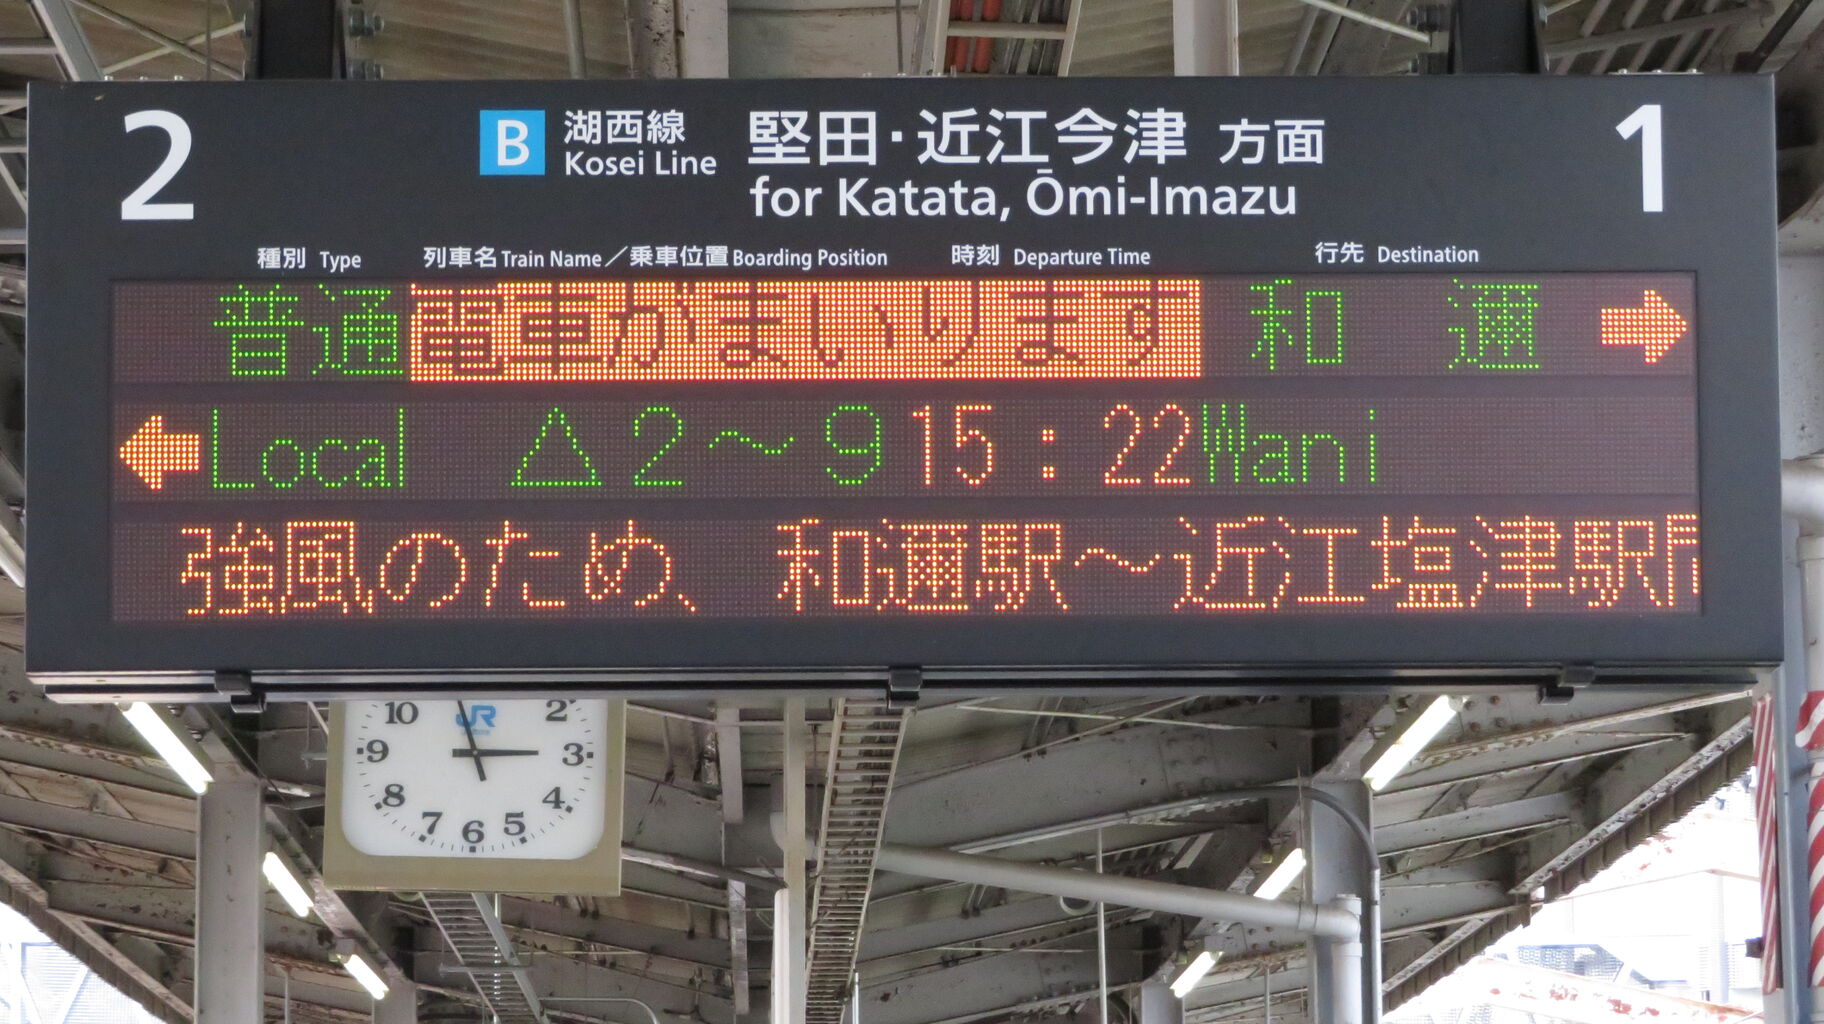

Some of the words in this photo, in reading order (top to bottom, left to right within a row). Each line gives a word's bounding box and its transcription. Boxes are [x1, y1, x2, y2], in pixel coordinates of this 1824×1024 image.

[564, 109, 686, 145] 湖西線
[497, 120, 530, 166] B
[1220, 118, 1326, 165] 方面
[121, 110, 195, 220] 2
[566, 150, 644, 176] Kosei
[655, 150, 717, 176] Line
[1616, 104, 1663, 212] 1
[750, 175, 822, 217] for
[839, 180, 1011, 222] Katata,
[1027, 168, 1296, 217] Ōmi-Imazu
[257, 246, 306, 270] 種別
[320, 251, 362, 273] Type
[424, 246, 497, 269] 列車名
[500, 249, 545, 268] Train
[733, 248, 813, 270] Boarding
[818, 248, 888, 267] Position
[951, 244, 1000, 267] 時刻
[1013, 248, 1103, 271] Departure
[1107, 247, 1151, 266] Time
[1315, 241, 1365, 264] 行先
[1378, 245, 1480, 264] Destination
[212, 282, 404, 378] 普通
[411, 282, 1198, 380] 電車がまいります
[211, 407, 405, 489] Local
[1202, 403, 1377, 483] Wani
[181, 519, 696, 615] 強風のため、
[385, 701, 419, 725] 10
[455, 705, 497, 728] JR
[545, 699, 569, 722] 2
[366, 739, 390, 763] 9
[562, 743, 585, 766] 3
[382, 783, 406, 808] 8
[542, 786, 565, 810] 4
[421, 811, 443, 836] 7
[462, 820, 485, 844] 6
[503, 811, 526, 836] 5
